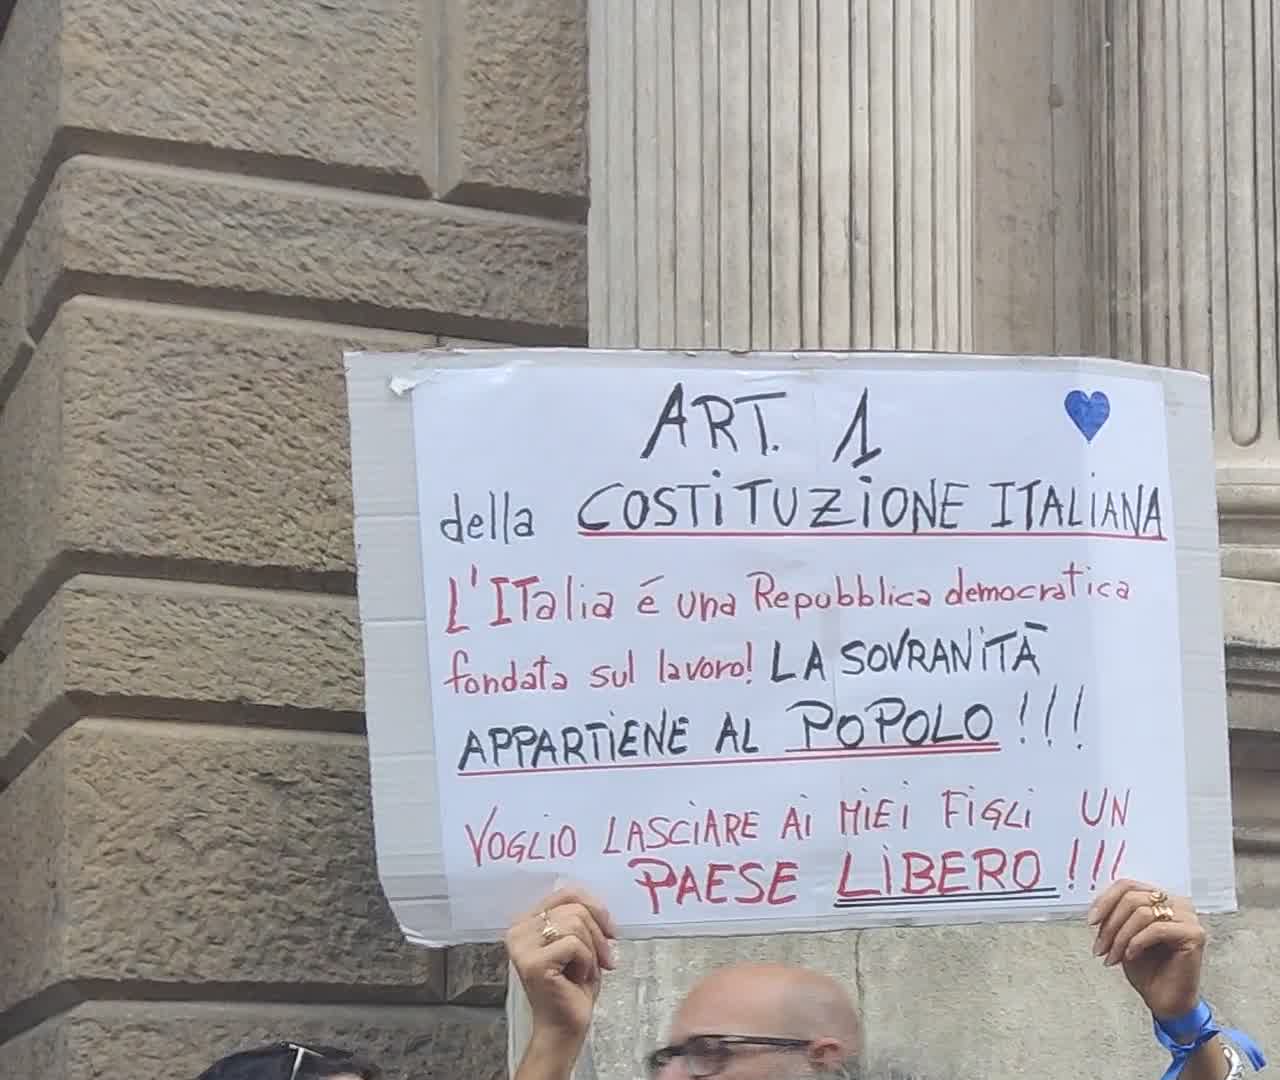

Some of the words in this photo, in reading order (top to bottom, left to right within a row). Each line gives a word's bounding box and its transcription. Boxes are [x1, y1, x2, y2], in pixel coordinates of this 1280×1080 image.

[640, 383, 786, 458] ART.
[833, 388, 881, 468] 1
[440, 491, 534, 544] della
[578, 470, 968, 530] COSTITUZIONE
[988, 472, 1163, 538] ITALIANA
[678, 592, 735, 621] una
[749, 572, 931, 620] Repubblica
[945, 562, 1128, 605] democratica
[444, 650, 567, 694] fondata
[591, 650, 633, 688] sul
[660, 642, 752, 684] lavoro!
[771, 640, 825, 682] LA
[841, 622, 1048, 674] SOVRANITÀ
[458, 709, 693, 770] APPARTIENE
[715, 712, 758, 753] AL
[786, 698, 998, 748] POPOLO
[466, 807, 576, 867] VOGLIO
[603, 803, 759, 859] LASCIARE
[781, 794, 810, 840] AI
[840, 781, 908, 835] MIEI
[942, 790, 1030, 830] FIGLI
[1082, 789, 1129, 826] UN
[628, 858, 798, 914] PAESE
[837, 848, 1042, 900] LIBERO
